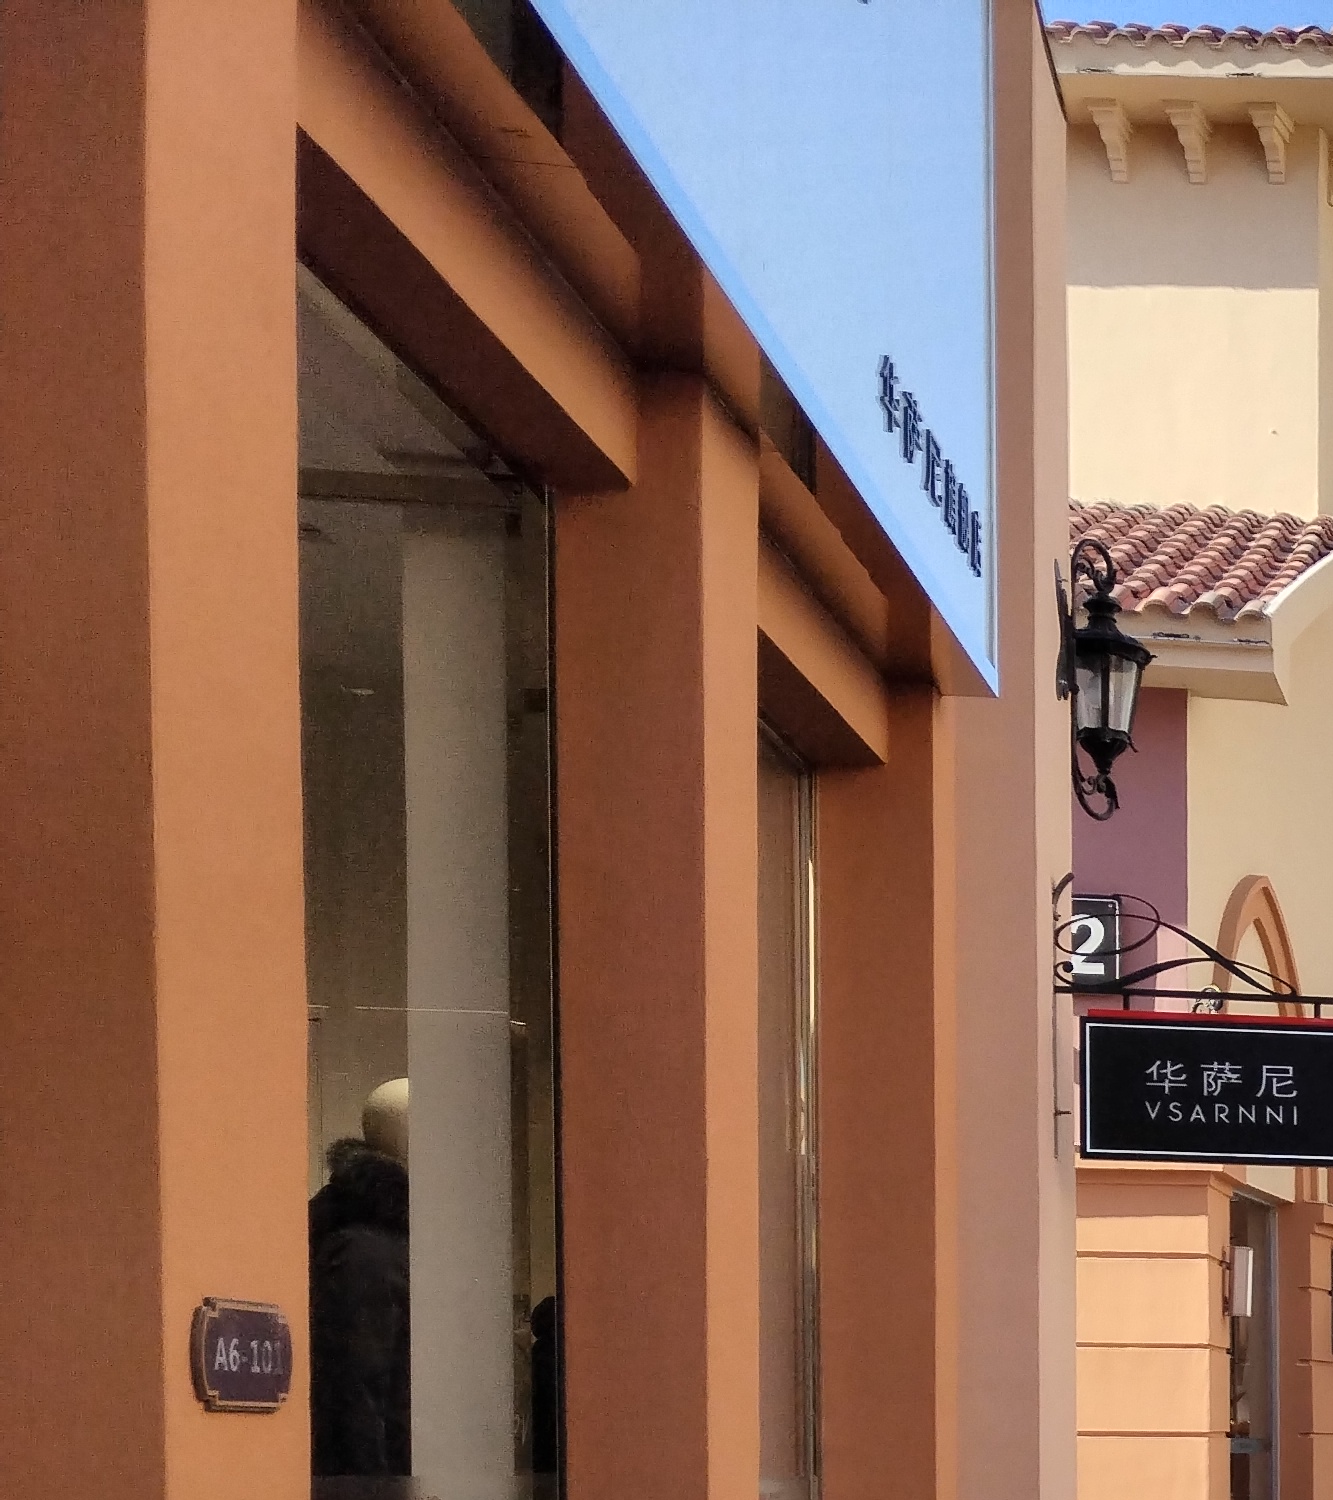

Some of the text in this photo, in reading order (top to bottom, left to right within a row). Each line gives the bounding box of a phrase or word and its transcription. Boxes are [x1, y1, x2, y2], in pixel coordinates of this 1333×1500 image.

[1145, 1060, 1298, 1099] 华萨尼
[1145, 1101, 1299, 1126] VSARNNI
[214, 1337, 284, 1374] A6-101
